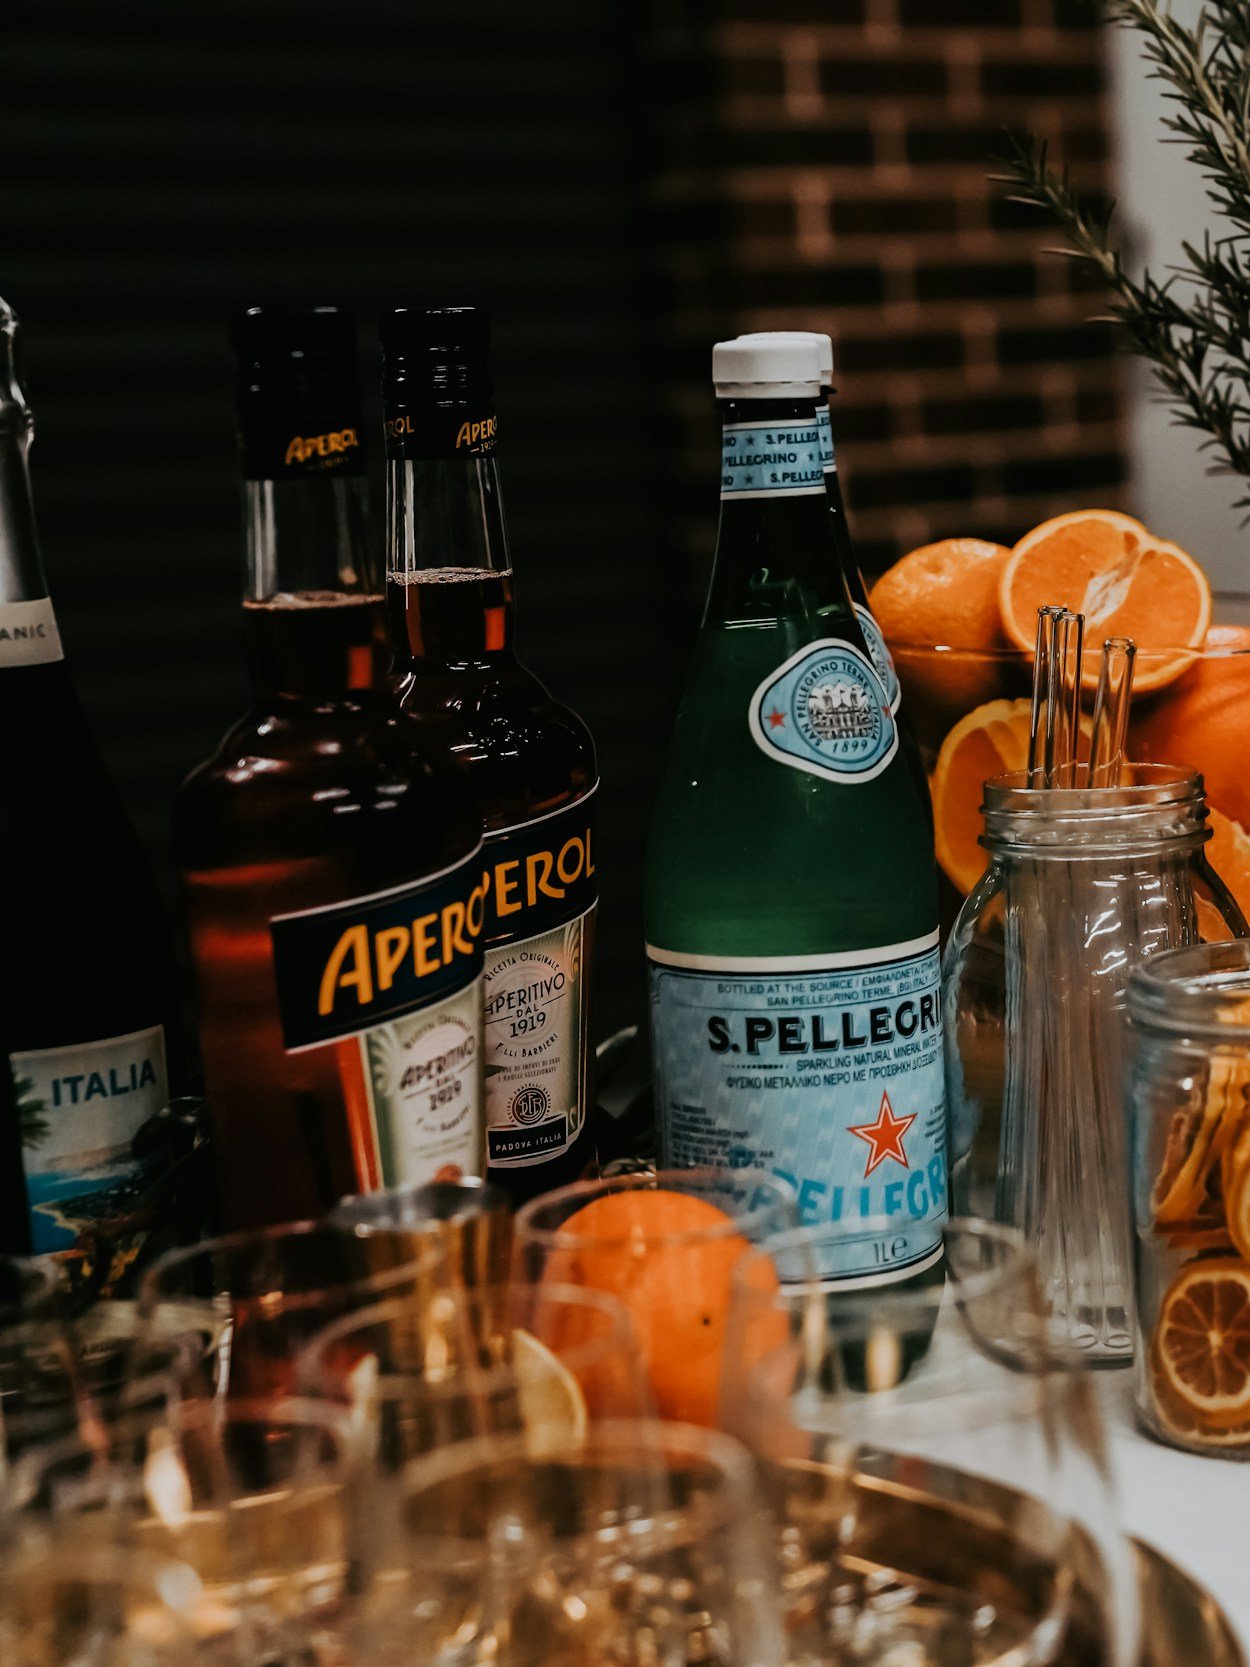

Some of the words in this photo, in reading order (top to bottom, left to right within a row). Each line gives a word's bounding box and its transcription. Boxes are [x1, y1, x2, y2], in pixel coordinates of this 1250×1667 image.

[843, 662, 869, 688] TERME
[797, 661, 839, 718] PELLEGRINO
[801, 724, 823, 747] SAN
[832, 740, 868, 753] 1899
[484, 957, 517, 981] RICETTA
[717, 983, 765, 994] BOTTLED
[766, 984, 781, 994] AT
[784, 983, 806, 993] THE
[809, 978, 853, 992] SOURCE
[767, 997, 789, 1006] SAN
[792, 990, 859, 1005] PELLEGRINO
[516, 1003, 540, 1018] DAL
[509, 1011, 546, 1038] 1919
[522, 1033, 558, 1057] BARBIERI
[797, 1056, 852, 1072] SPARKLING
[853, 1050, 892, 1065] NATURAL
[52, 1059, 157, 1107] ITALIA
[495, 1140, 532, 1152] PADOVA
[535, 1132, 562, 1146] ITALIA
